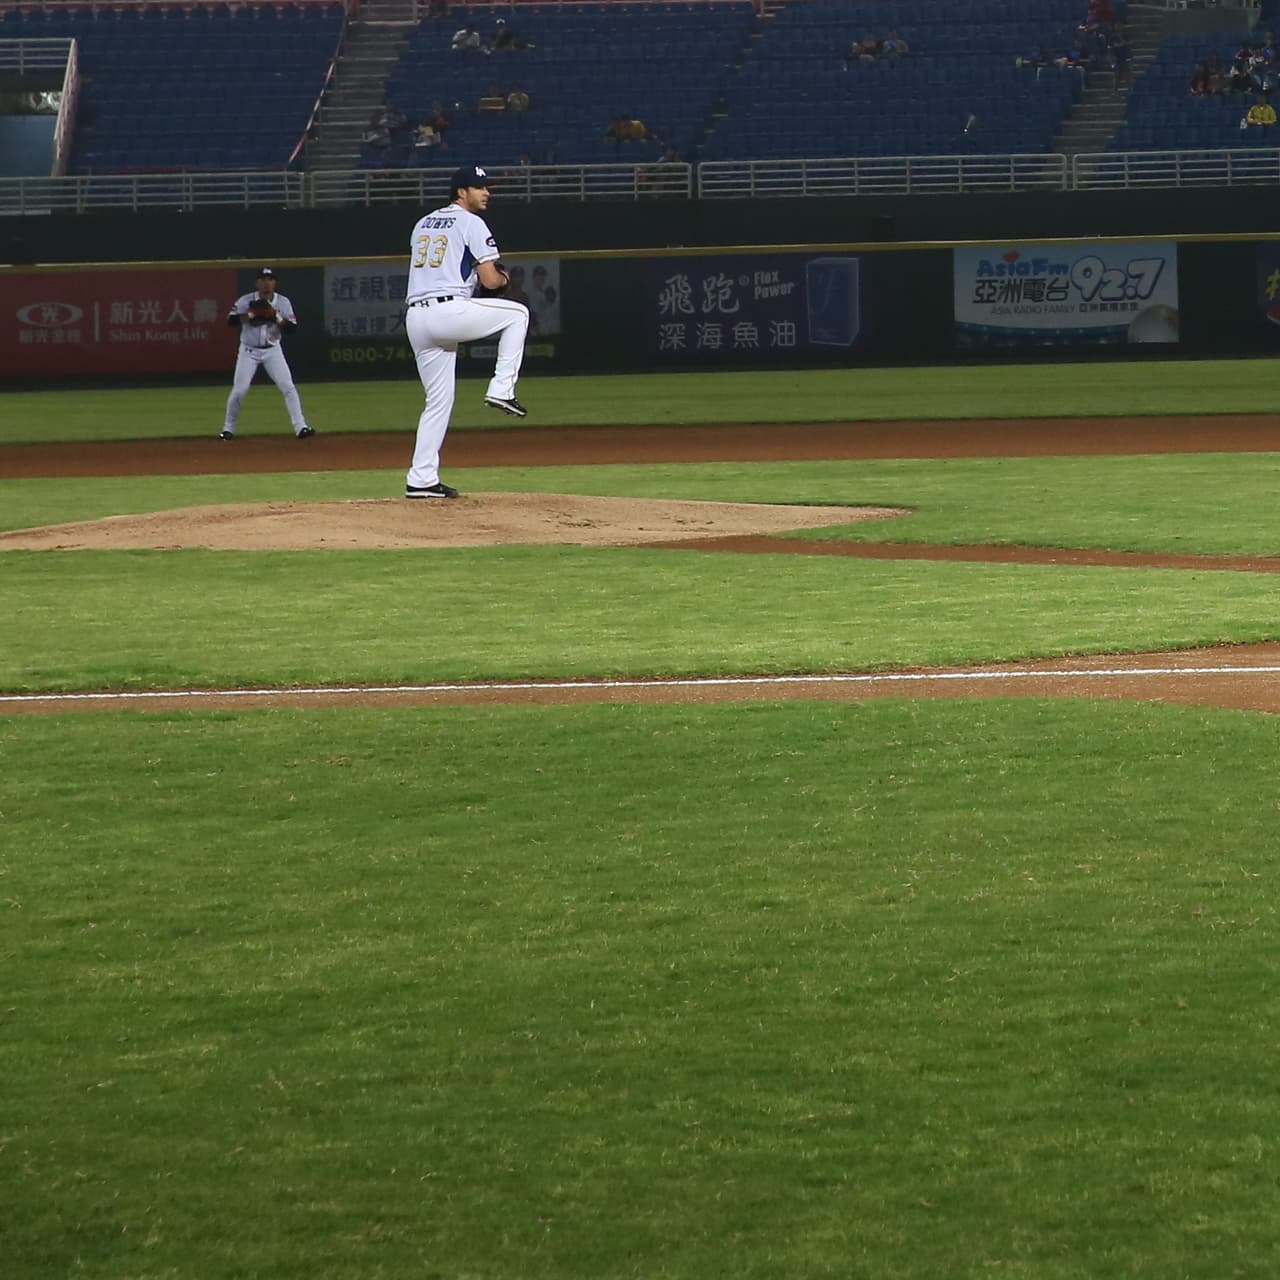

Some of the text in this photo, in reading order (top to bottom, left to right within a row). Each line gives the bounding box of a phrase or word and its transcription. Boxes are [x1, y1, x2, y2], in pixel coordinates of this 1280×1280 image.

[414, 234, 449, 269] 33
[753, 282, 795, 300] Power
[973, 277, 1071, 304] 亞洲電台
[1070, 254, 1166, 302] 92.7
[1014, 304, 1042, 314] RADIO
[1044, 303, 1075, 313] FAMILY
[109, 327, 142, 343] Shin
[145, 327, 179, 344] Kong
[658, 320, 797, 351] 深海魚油
